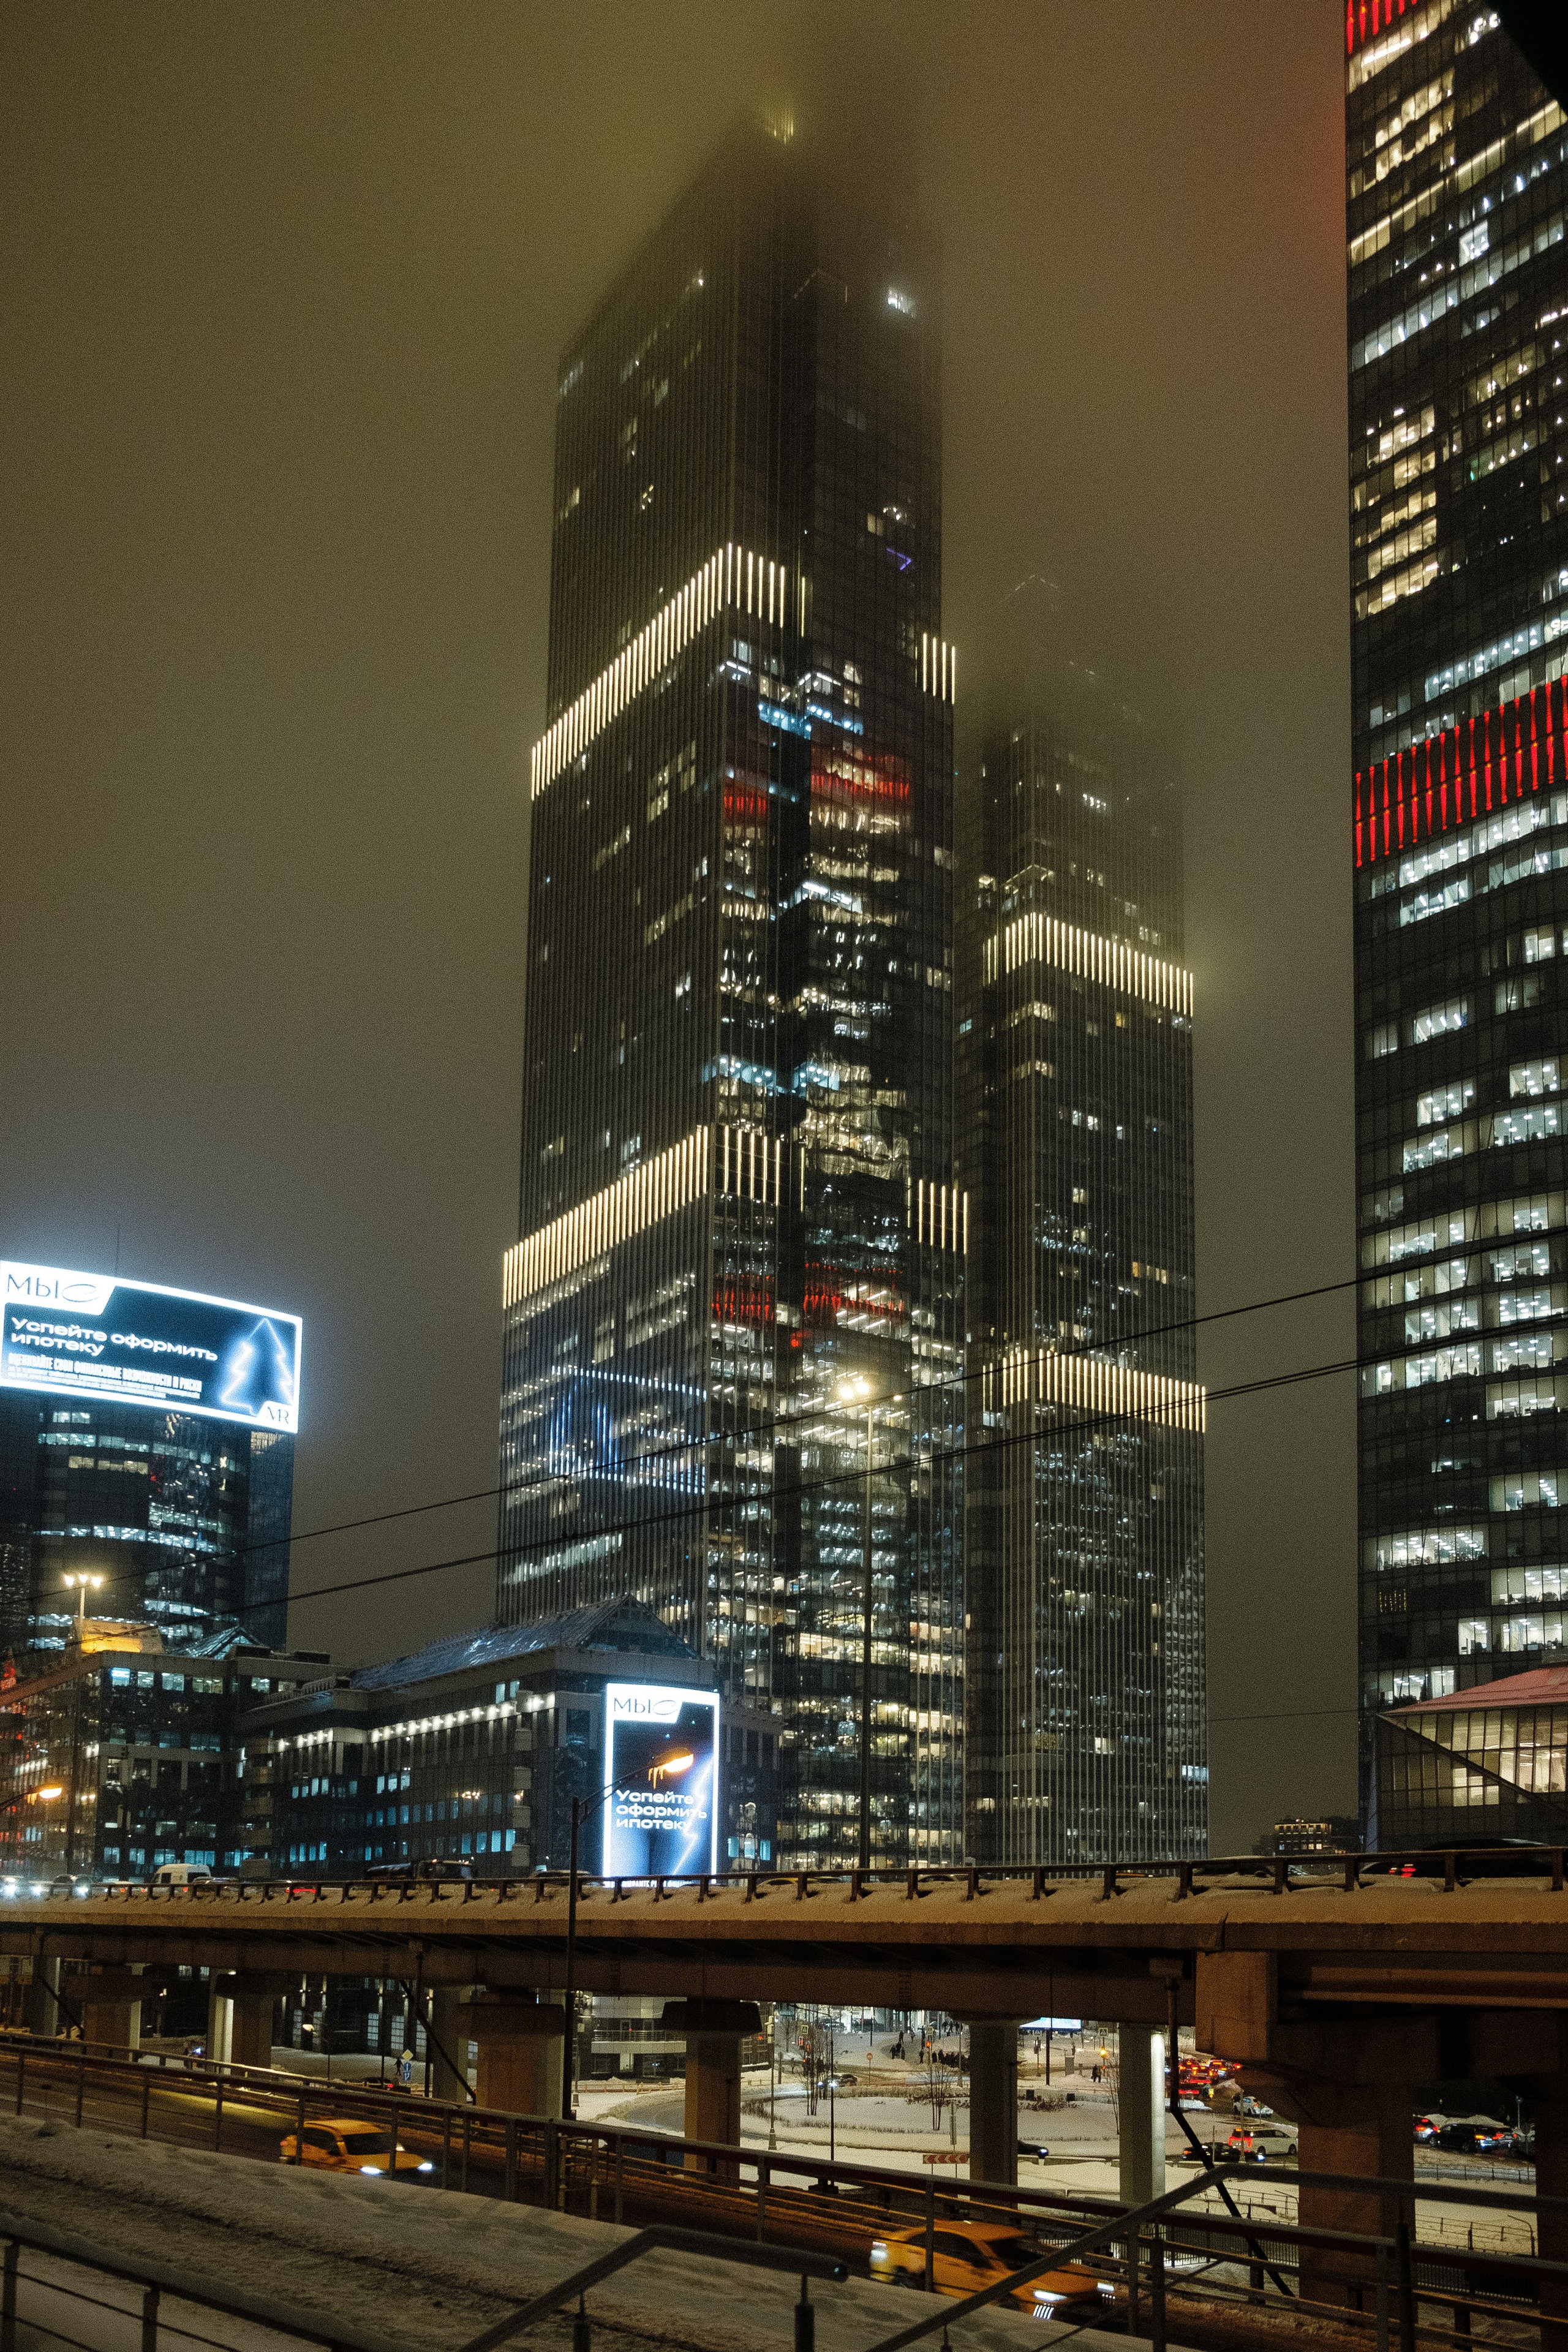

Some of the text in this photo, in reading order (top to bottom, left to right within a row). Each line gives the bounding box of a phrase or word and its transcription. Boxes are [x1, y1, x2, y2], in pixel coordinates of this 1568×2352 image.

[11, 1316, 219, 1361] Успейте оформить
[11, 1333, 105, 1356] ипотеку
[266, 1406, 289, 1423] MR
[616, 1789, 693, 1804] Успейте
[616, 1803, 707, 1819] оформить
[616, 1818, 692, 1832] ипотеку
